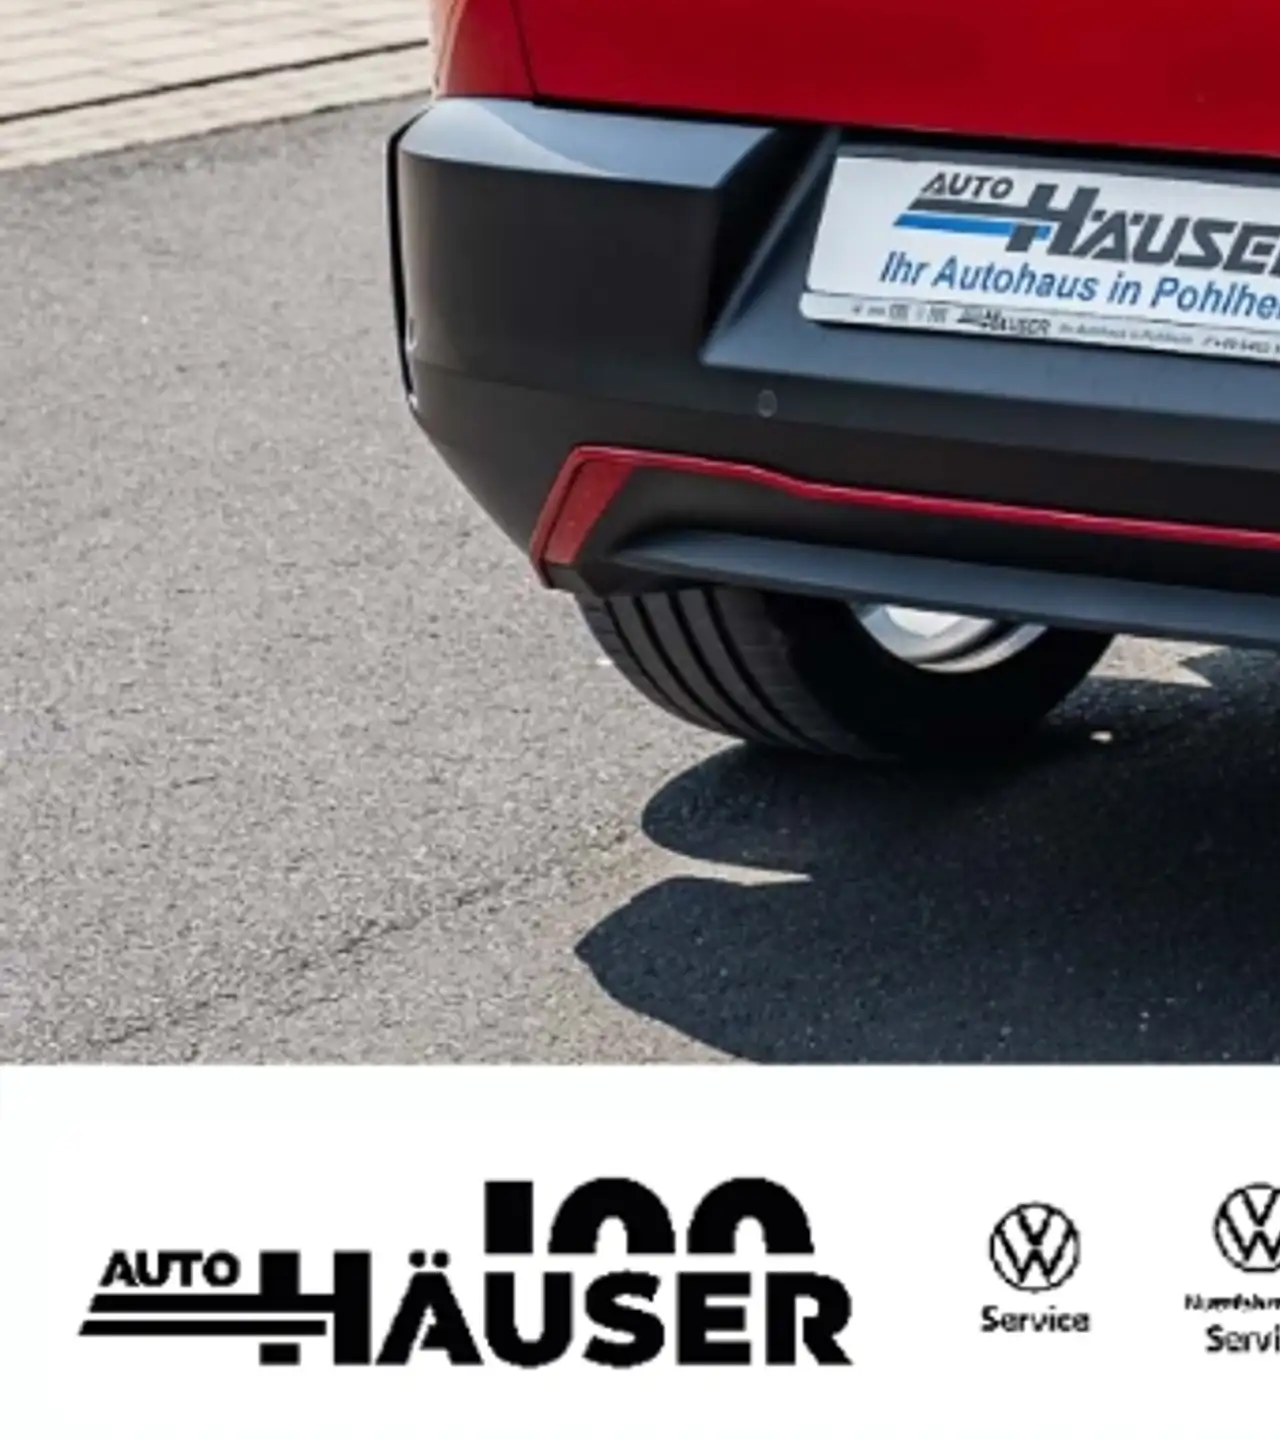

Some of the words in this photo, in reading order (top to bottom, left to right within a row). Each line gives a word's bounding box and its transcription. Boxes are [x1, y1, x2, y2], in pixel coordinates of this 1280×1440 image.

[922, 172, 1014, 200] AUTO
[879, 250, 926, 286] Ihr
[932, 256, 1099, 303] Autohaus
[1109, 271, 1142, 305] in
